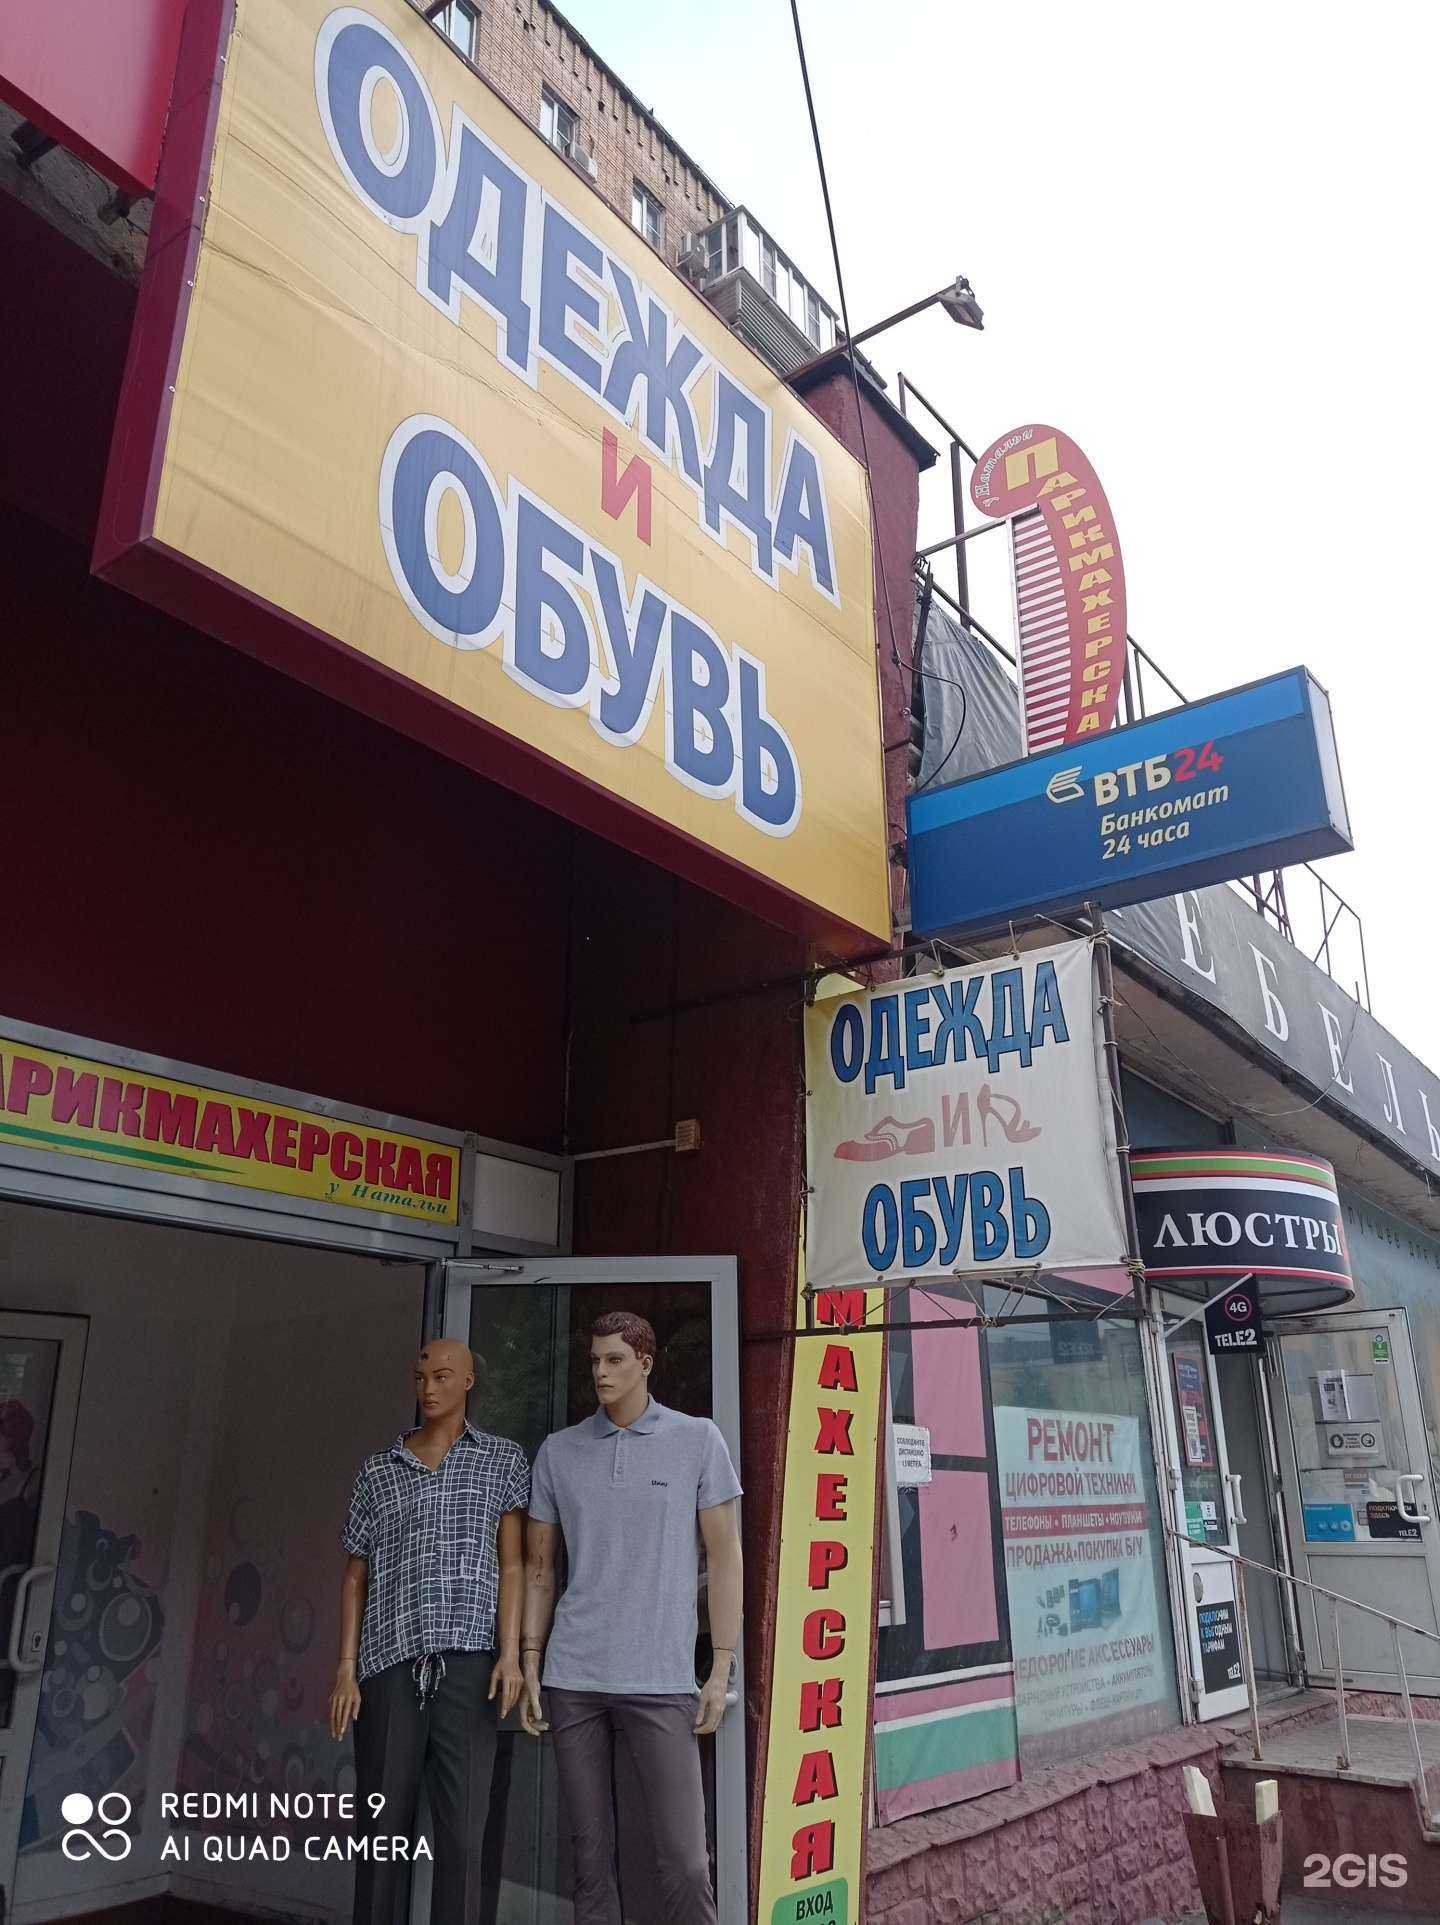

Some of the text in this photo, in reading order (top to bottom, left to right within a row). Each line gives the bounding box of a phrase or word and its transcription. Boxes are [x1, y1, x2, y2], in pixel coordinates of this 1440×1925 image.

[315, 7, 841, 608] ОДЕЖДА
[600, 426, 652, 547] И
[379, 413, 803, 837] ОБУВЬ
[1100, 785, 1229, 836] Банкомат
[1102, 821, 1190, 860] 24 часа
[831, 960, 1070, 1095] ОДЕЖДА
[0, 1053, 452, 1201] РИКМАХЕРСКАЯ
[941, 1092, 972, 1147] И
[351, 1184, 448, 1214] Натальи
[862, 1166, 1051, 1271] ОБУВЬ
[1153, 1211, 1343, 1256] ЛЮСТРЫ
[1228, 1303, 1248, 1313] 4G
[1214, 1328, 1257, 1347] TELE2
[1027, 1418, 1114, 1462] РЕМОНТ
[1005, 1467, 1137, 1502] ЦИФРОВОЙ ТЕХНИКИ
[1005, 1514, 1052, 1531] ТЕЛЕФОНЫ
[1061, 1513, 1104, 1529] ПЛАНШЕТЫ
[1124, 1536, 1143, 1557] Б/У
[790, 1289, 867, 1881] МАХЕРСКАЯ
[1087, 1633, 1153, 1664] АКСЕССУАРЫ
[796, 1890, 834, 1920] ВХОД
